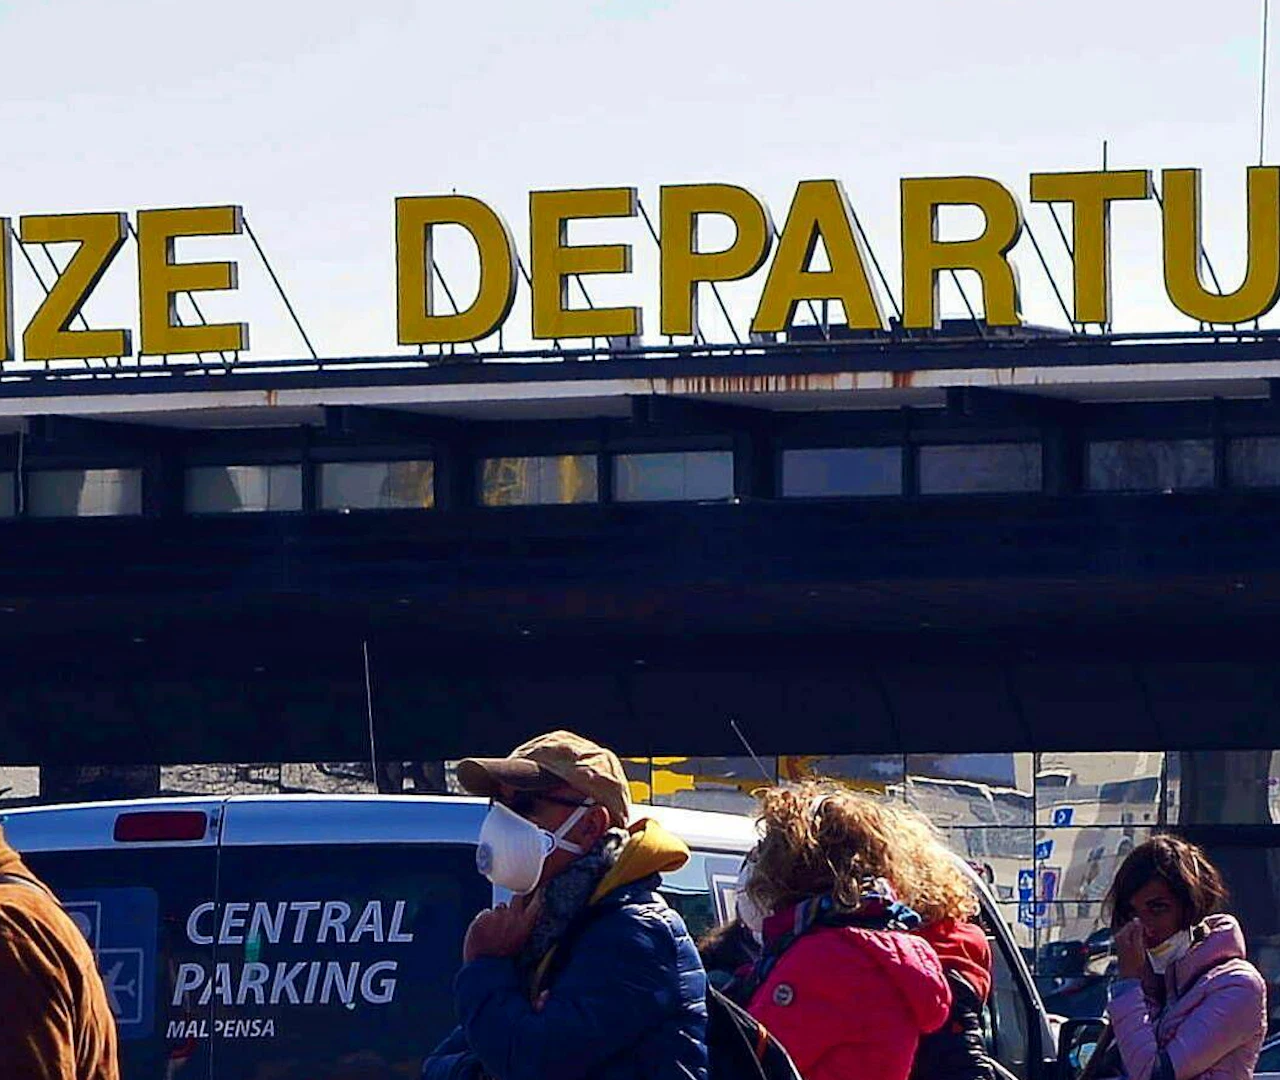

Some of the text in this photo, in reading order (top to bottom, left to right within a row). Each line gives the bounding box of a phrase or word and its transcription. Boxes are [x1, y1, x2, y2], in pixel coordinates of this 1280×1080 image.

[186, 900, 414, 945] CENTRAL
[172, 960, 399, 1006] PARKING
[166, 1018, 276, 1039] MALPENSA
